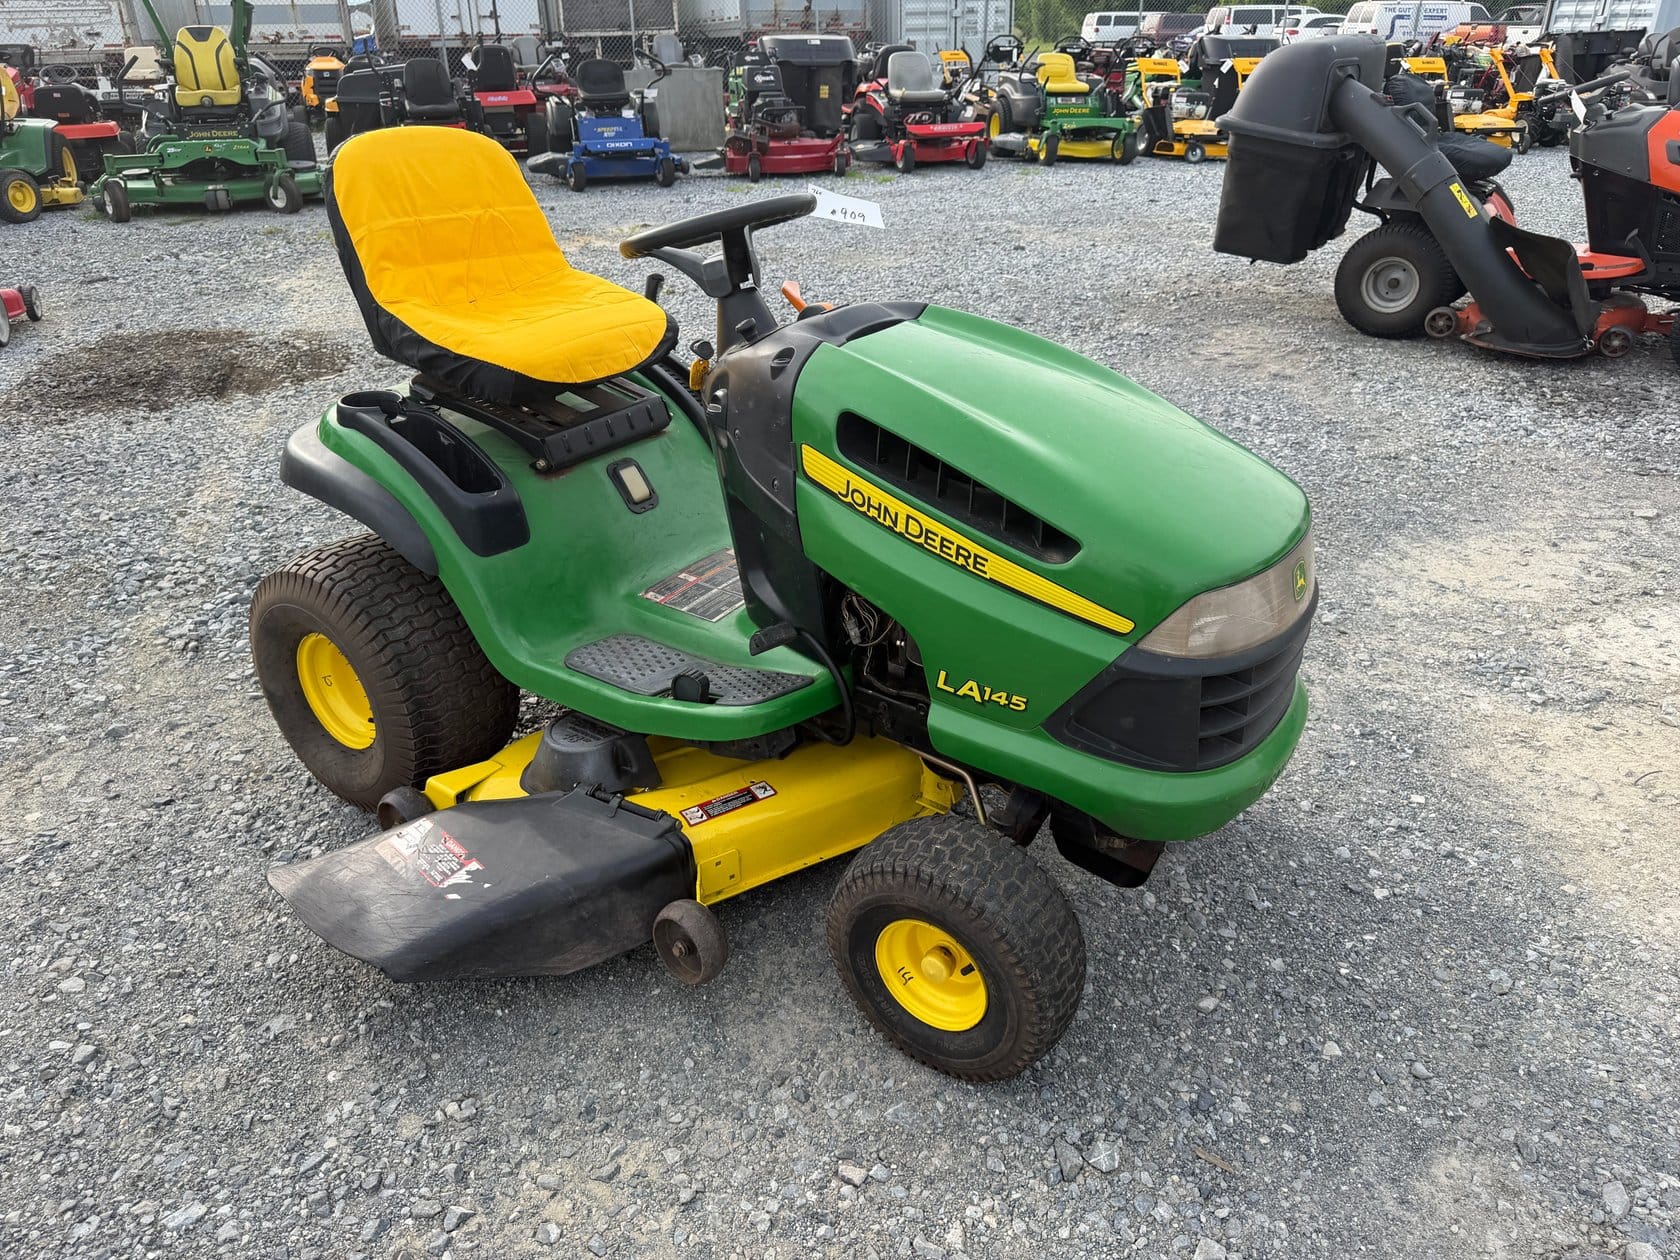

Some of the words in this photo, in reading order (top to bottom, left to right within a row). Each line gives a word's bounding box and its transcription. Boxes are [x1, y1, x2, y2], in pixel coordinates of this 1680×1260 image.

[189, 130, 210, 138] JOHN
[837, 479, 899, 530] JOHN
[904, 515, 989, 576] DEERE
[937, 670, 1028, 712] LA145
[897, 966, 914, 986] 14
